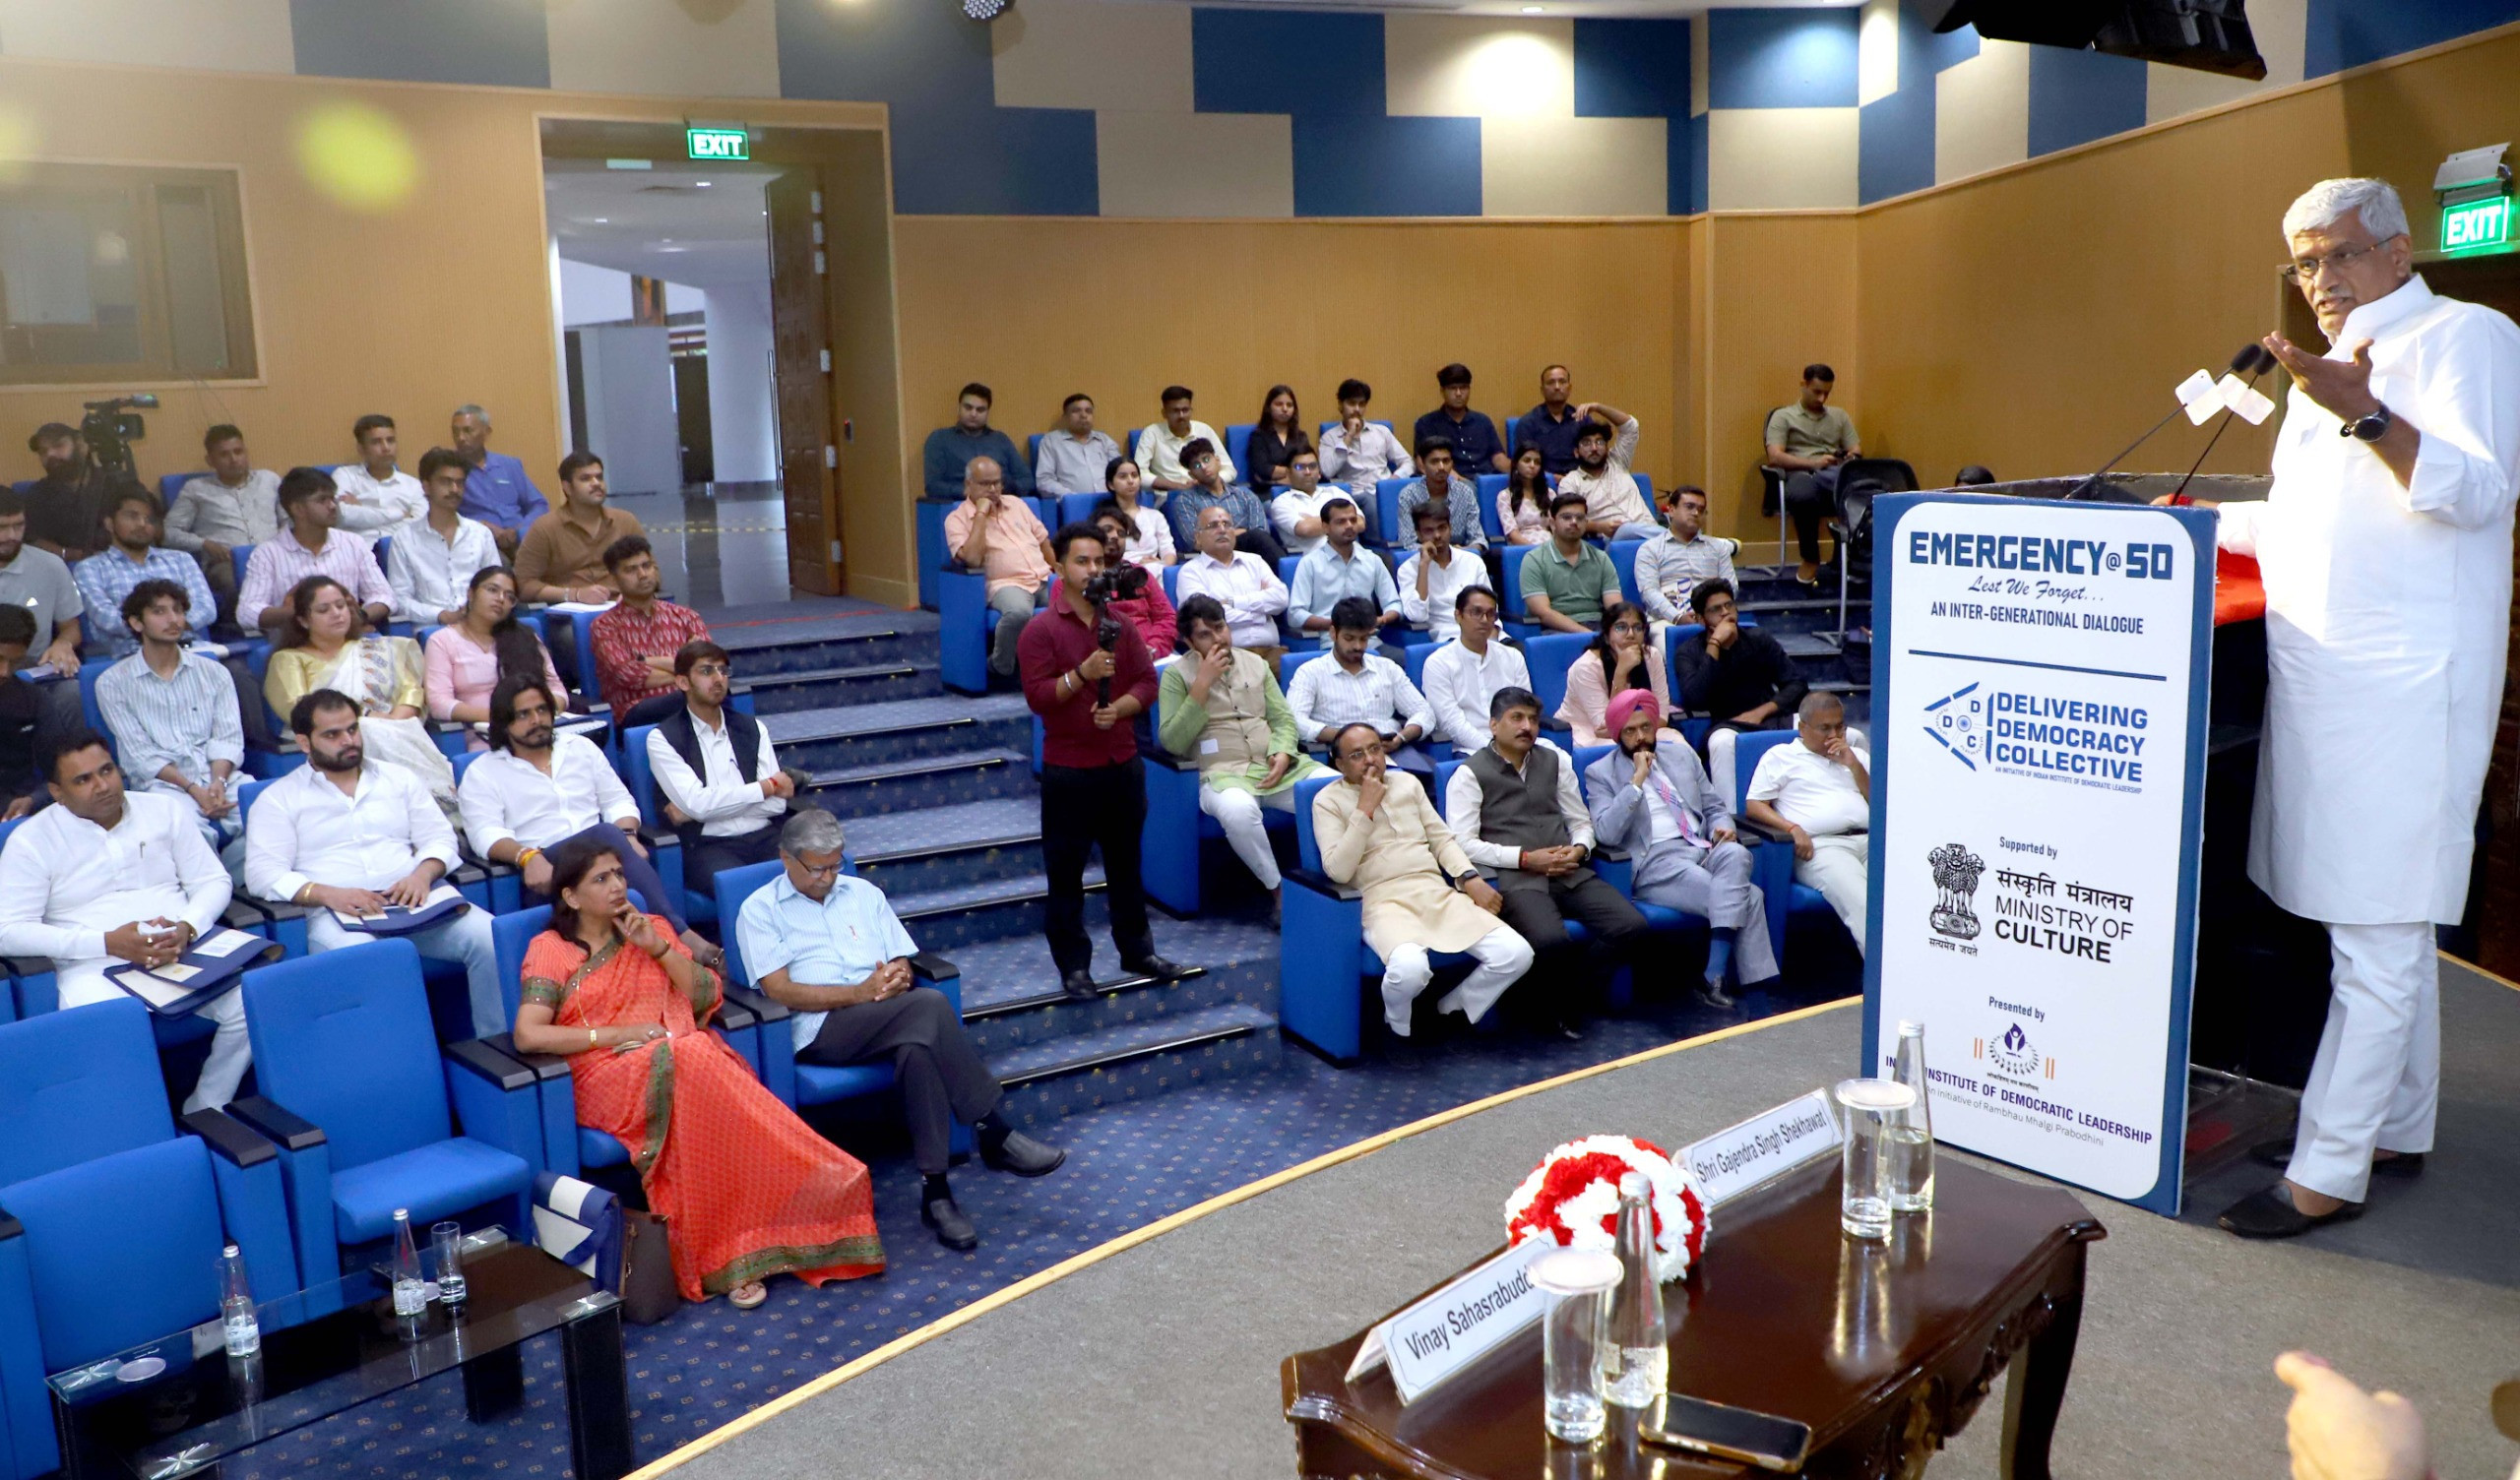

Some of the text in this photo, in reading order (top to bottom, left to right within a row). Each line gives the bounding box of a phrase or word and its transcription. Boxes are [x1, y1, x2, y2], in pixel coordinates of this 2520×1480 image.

[693, 133, 743, 156] EXIT
[2446, 205, 2502, 246] EXIT
[1968, 575, 2002, 593] Lest
[2005, 578, 2030, 595] We
[1930, 601, 2144, 635] AN INTER-GENERATIONAL DIALOGUE
[1996, 692, 2148, 730] DELIVERING
[1996, 718, 2145, 757] DEMOCRACY
[1996, 743, 2143, 782] COLLECTIVE
[1999, 836, 2058, 860] Supported by
[1995, 867, 2134, 913] संस्कृति मंत्रालय
[1995, 894, 2134, 941] MINISTRY OF
[1928, 938, 1979, 957] सत्यमेव जयते
[1995, 919, 2111, 963] CULTURE
[1988, 995, 2046, 1022] Presented by
[1924, 1066, 1979, 1092] INSTITUTE
[1983, 1083, 1997, 1098] OF
[2001, 1088, 2074, 1122] DEMOCRATIC
[2078, 1111, 2153, 1145] LEADERSHIP
[1937, 1087, 1973, 1106] initiative
[1973, 1100, 1984, 1110] of
[1984, 1102, 2024, 1123] Rambhau
[2026, 1114, 2054, 1134] Mhalgi
[2055, 1124, 2105, 1147] Prabodhini
[1696, 1109, 1827, 1184] Shri Gajendra Singh Shekhawat
[1405, 1325, 1450, 1361] Vinay
